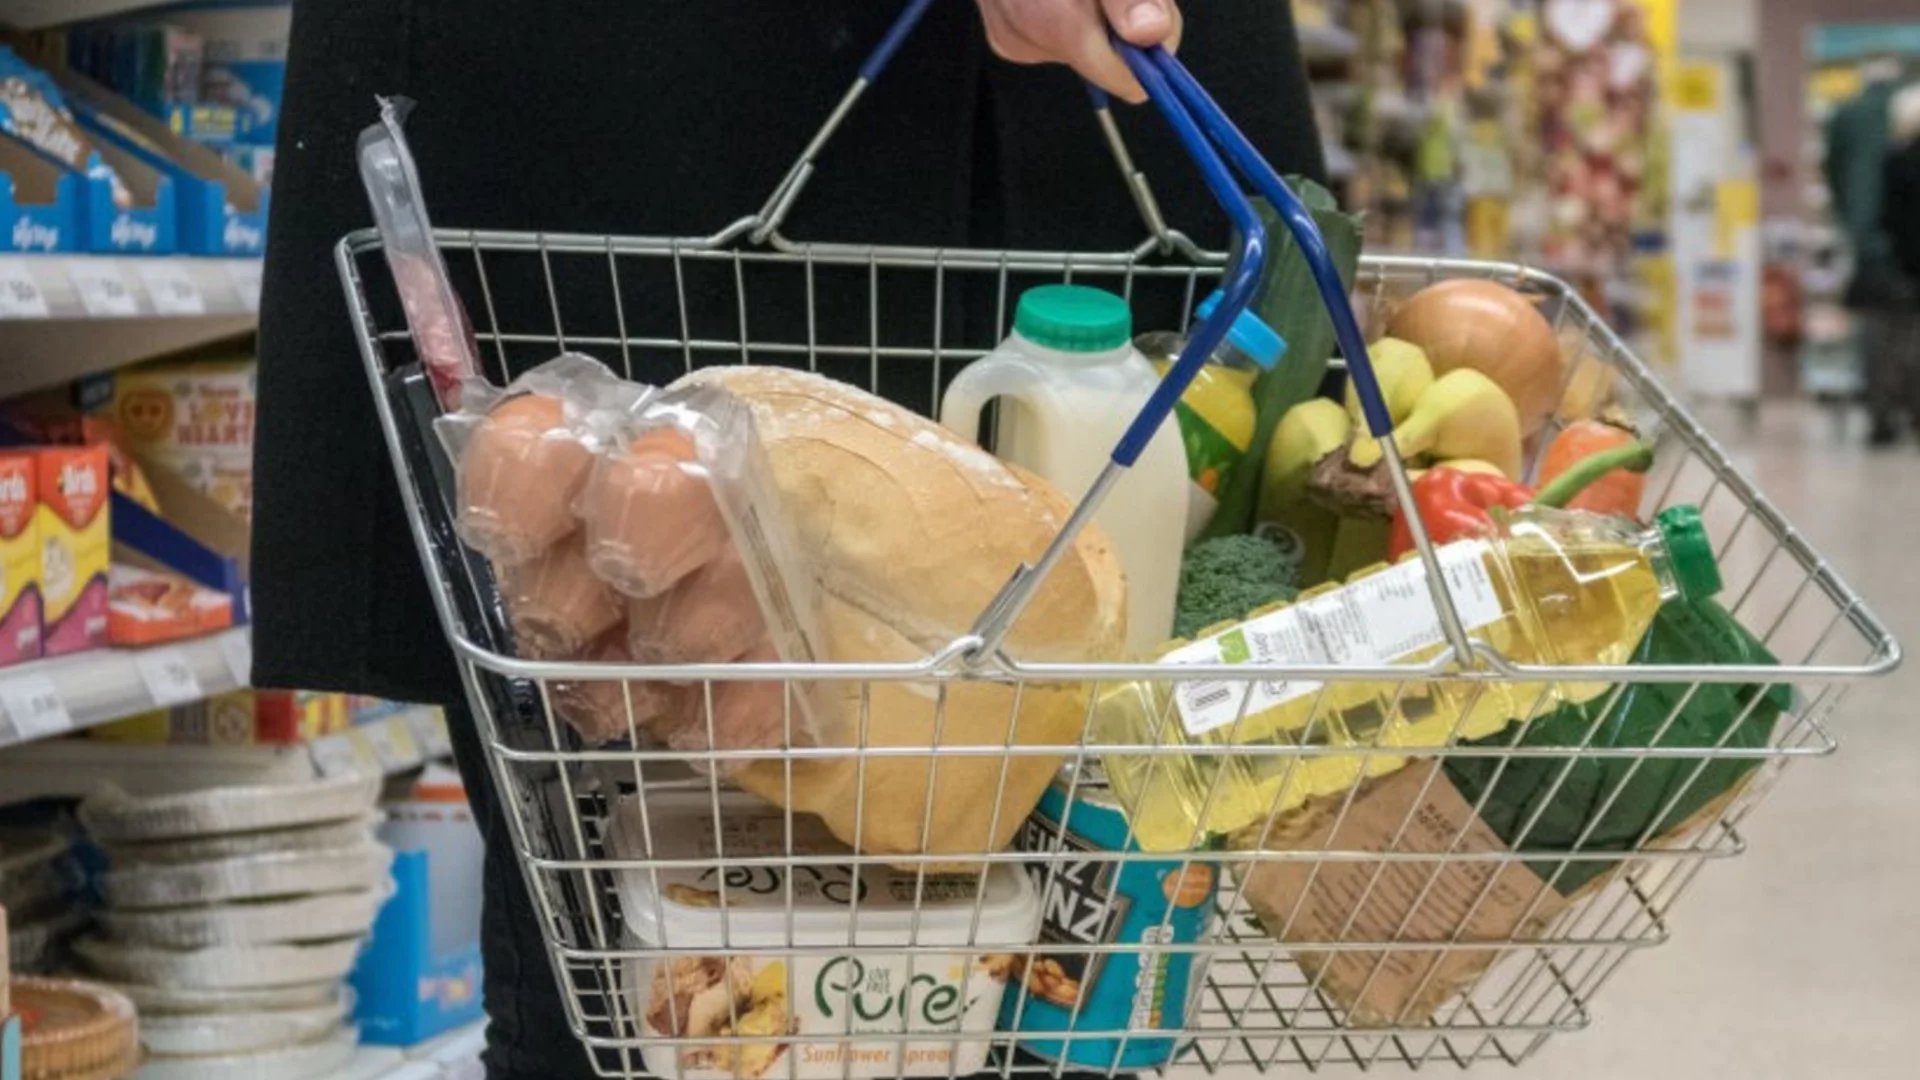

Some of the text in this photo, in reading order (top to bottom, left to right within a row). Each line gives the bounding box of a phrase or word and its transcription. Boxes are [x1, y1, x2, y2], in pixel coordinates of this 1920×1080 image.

[814, 955, 981, 1026] Pure
[802, 1040, 892, 1064] Sunfower
[903, 1042, 958, 1065] prea
